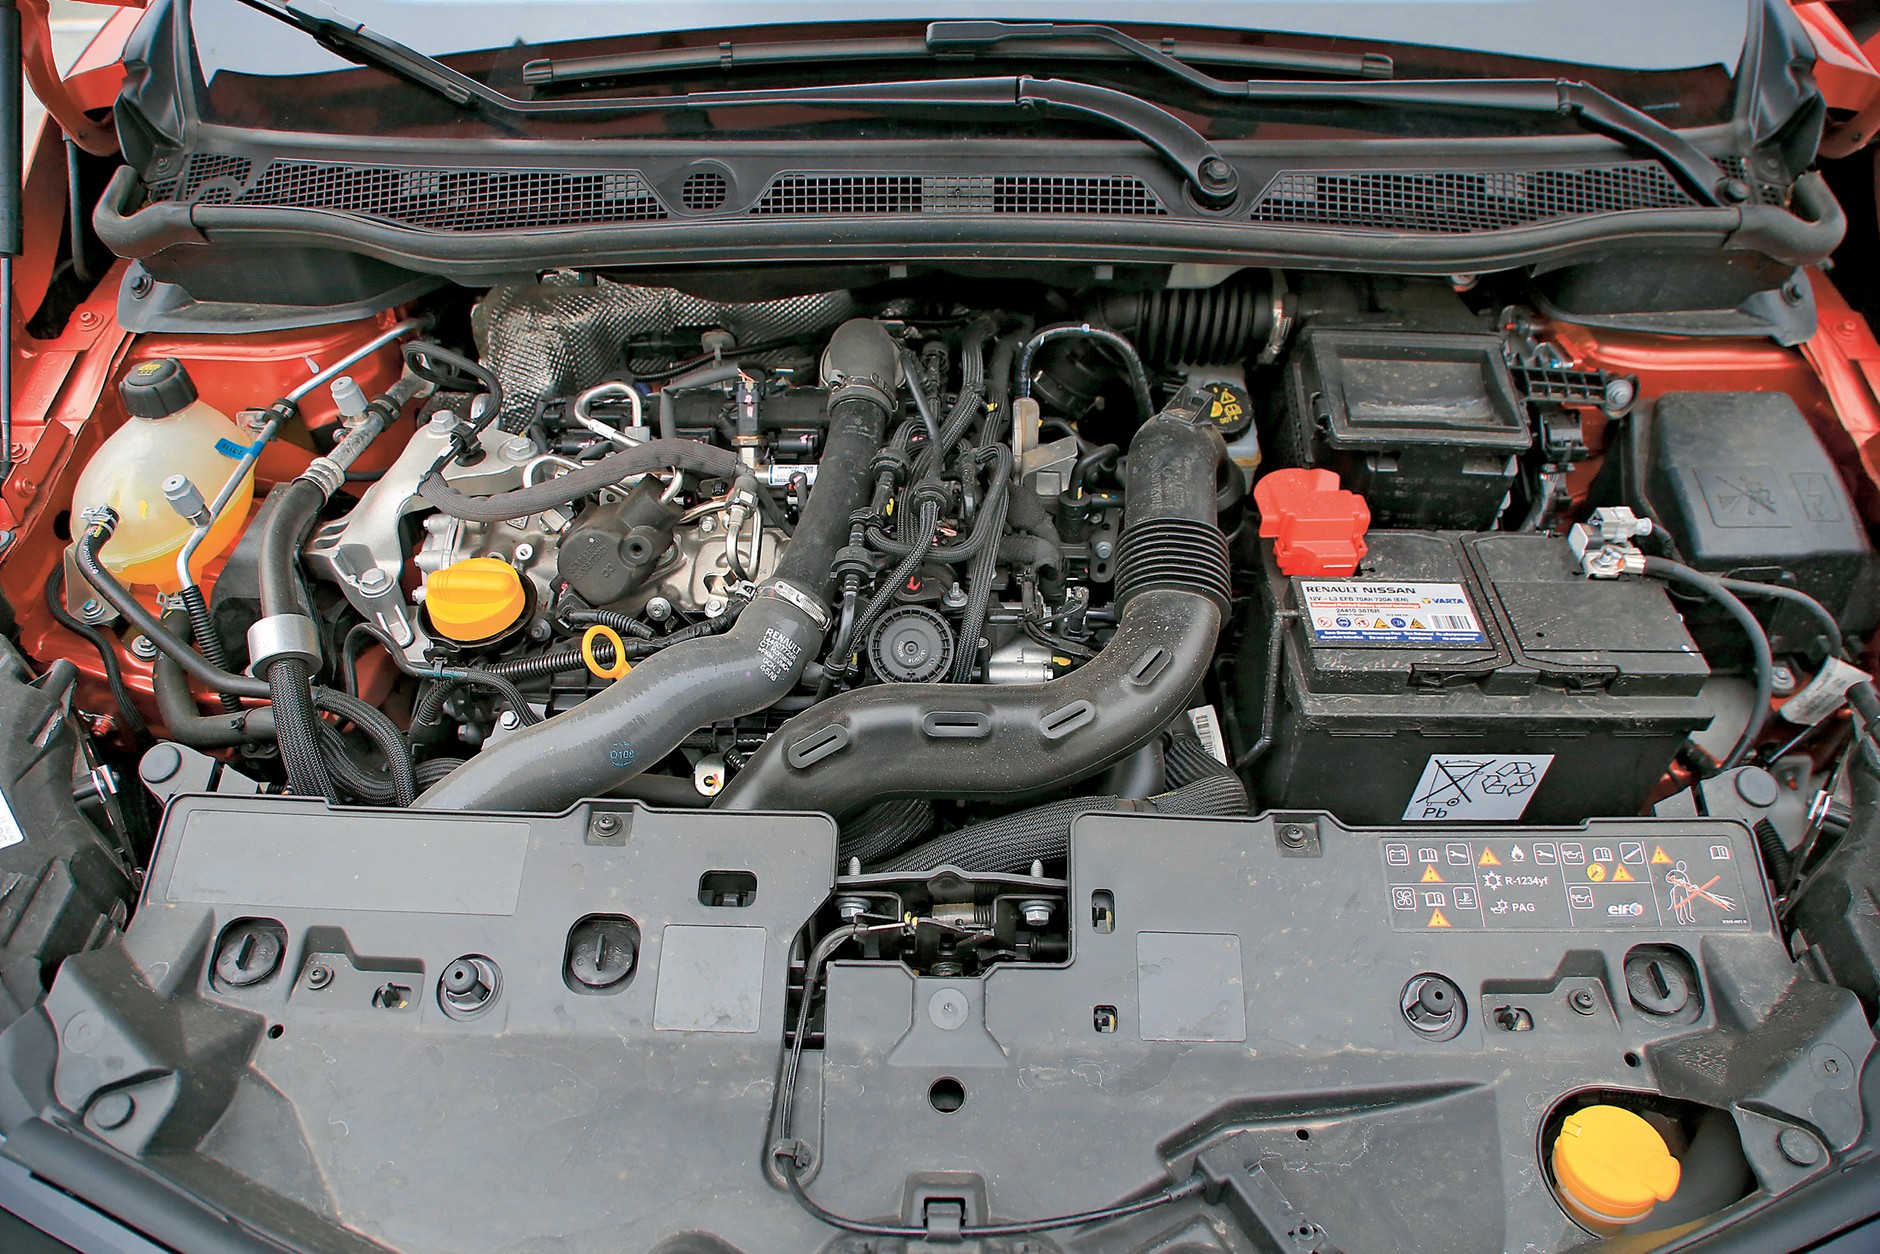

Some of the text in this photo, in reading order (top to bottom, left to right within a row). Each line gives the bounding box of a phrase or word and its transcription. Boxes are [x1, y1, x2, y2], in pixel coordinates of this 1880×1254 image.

[1362, 586, 1416, 594] NISSAN
[765, 628, 802, 655] RENAULT
[1422, 807, 1448, 818] Pb
[1504, 876, 1548, 887] R-1234yf
[1511, 903, 1535, 912] PAG
[1607, 904, 1630, 915] elf
